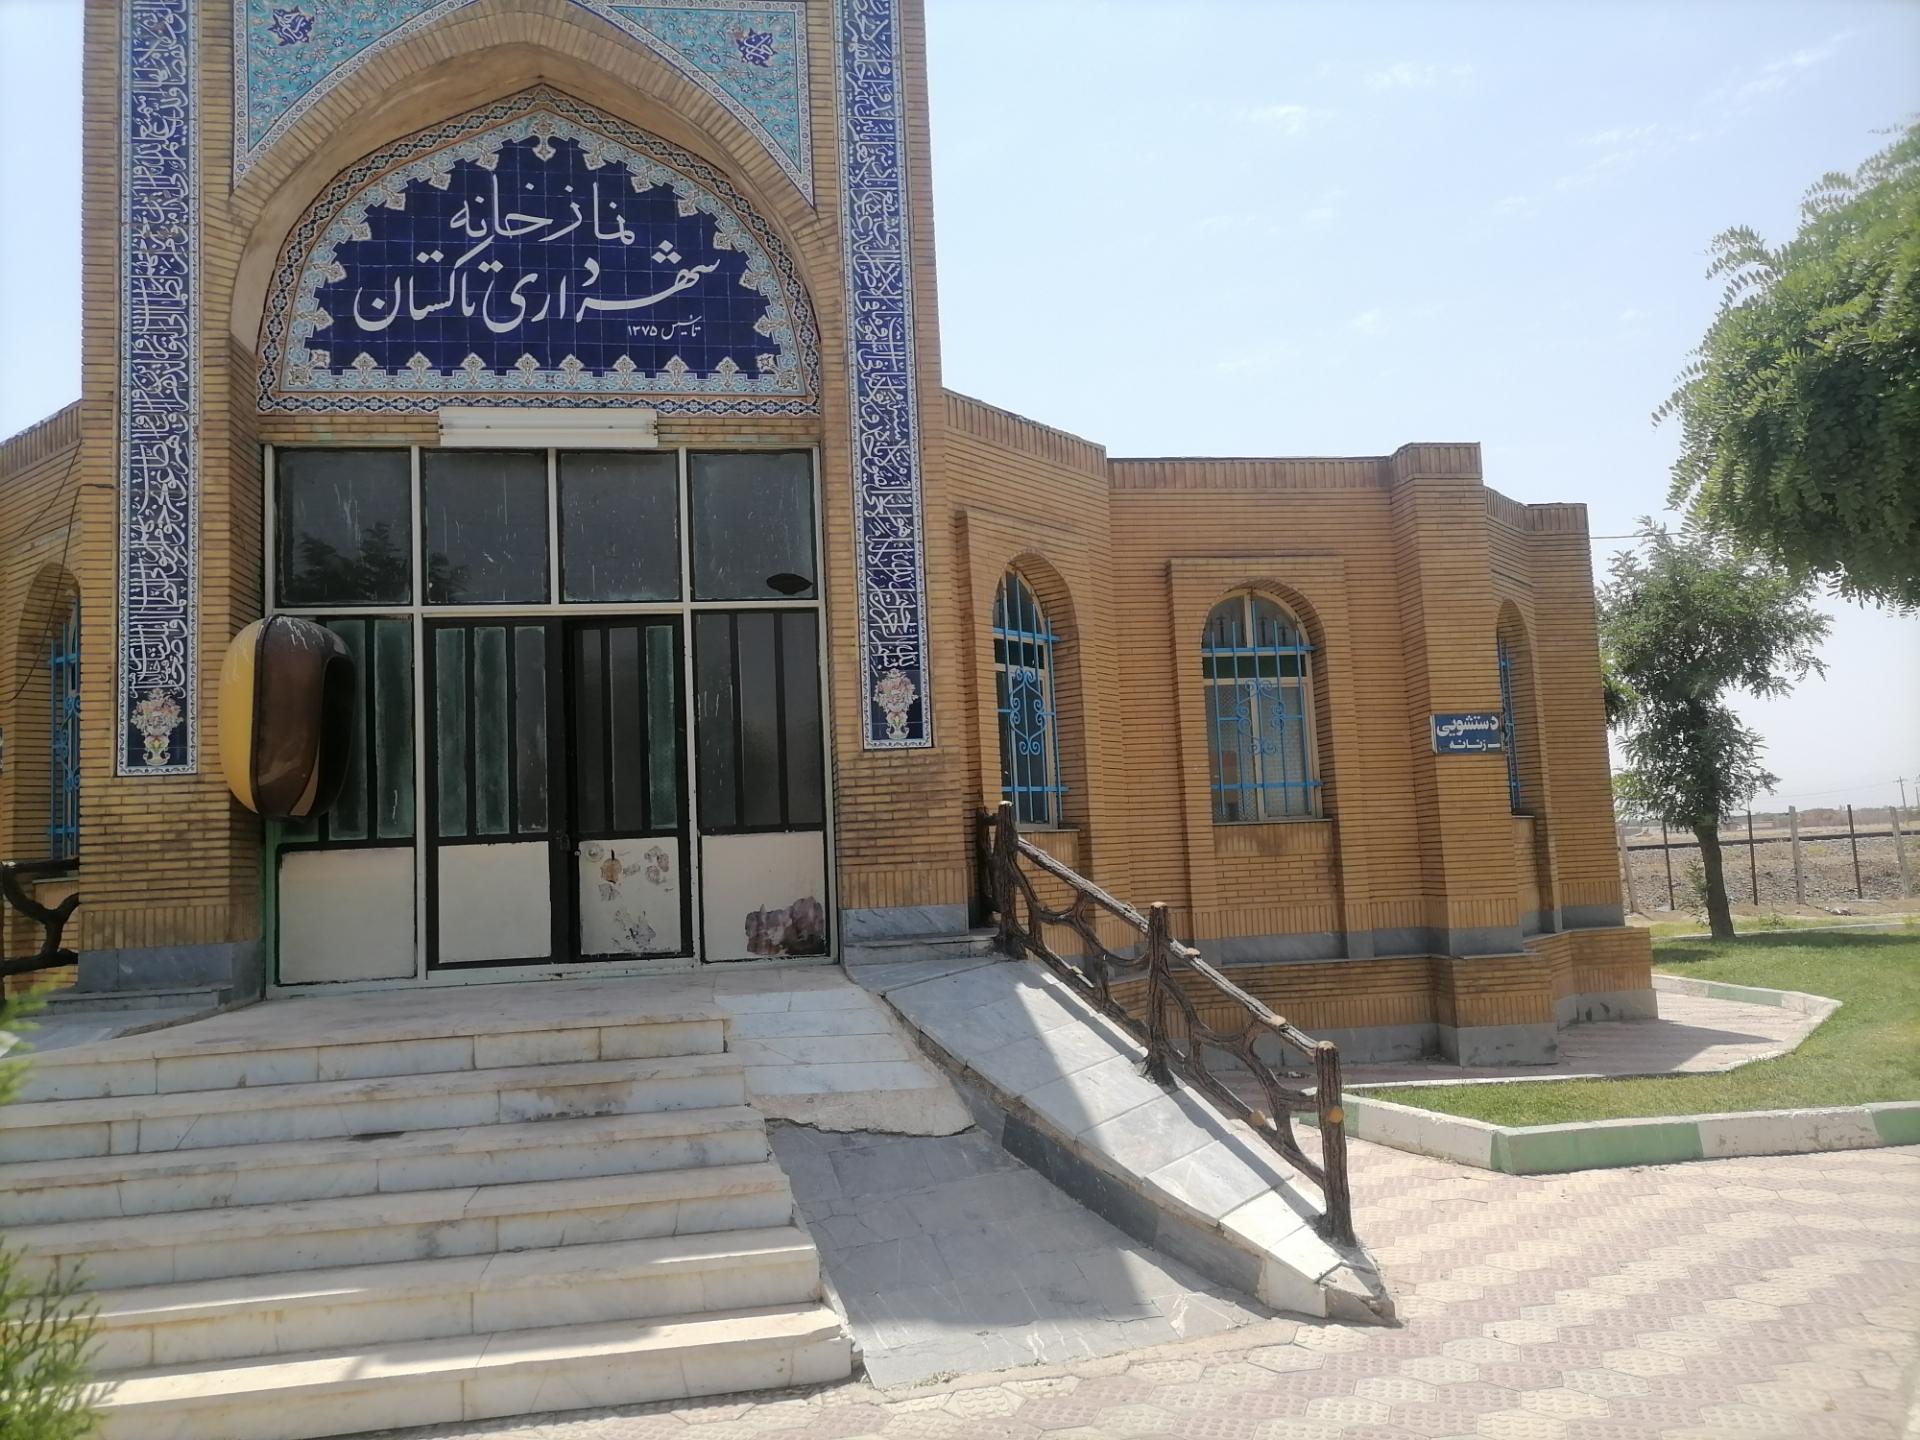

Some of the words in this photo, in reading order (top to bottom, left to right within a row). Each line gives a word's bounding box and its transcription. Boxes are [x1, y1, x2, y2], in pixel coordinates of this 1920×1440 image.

[353, 235, 504, 332] تاکستان
[483, 240, 720, 333] شهرداری
[627, 325, 658, 337] ۱۳۷۵
[1436, 715, 1499, 737] دستشویی
